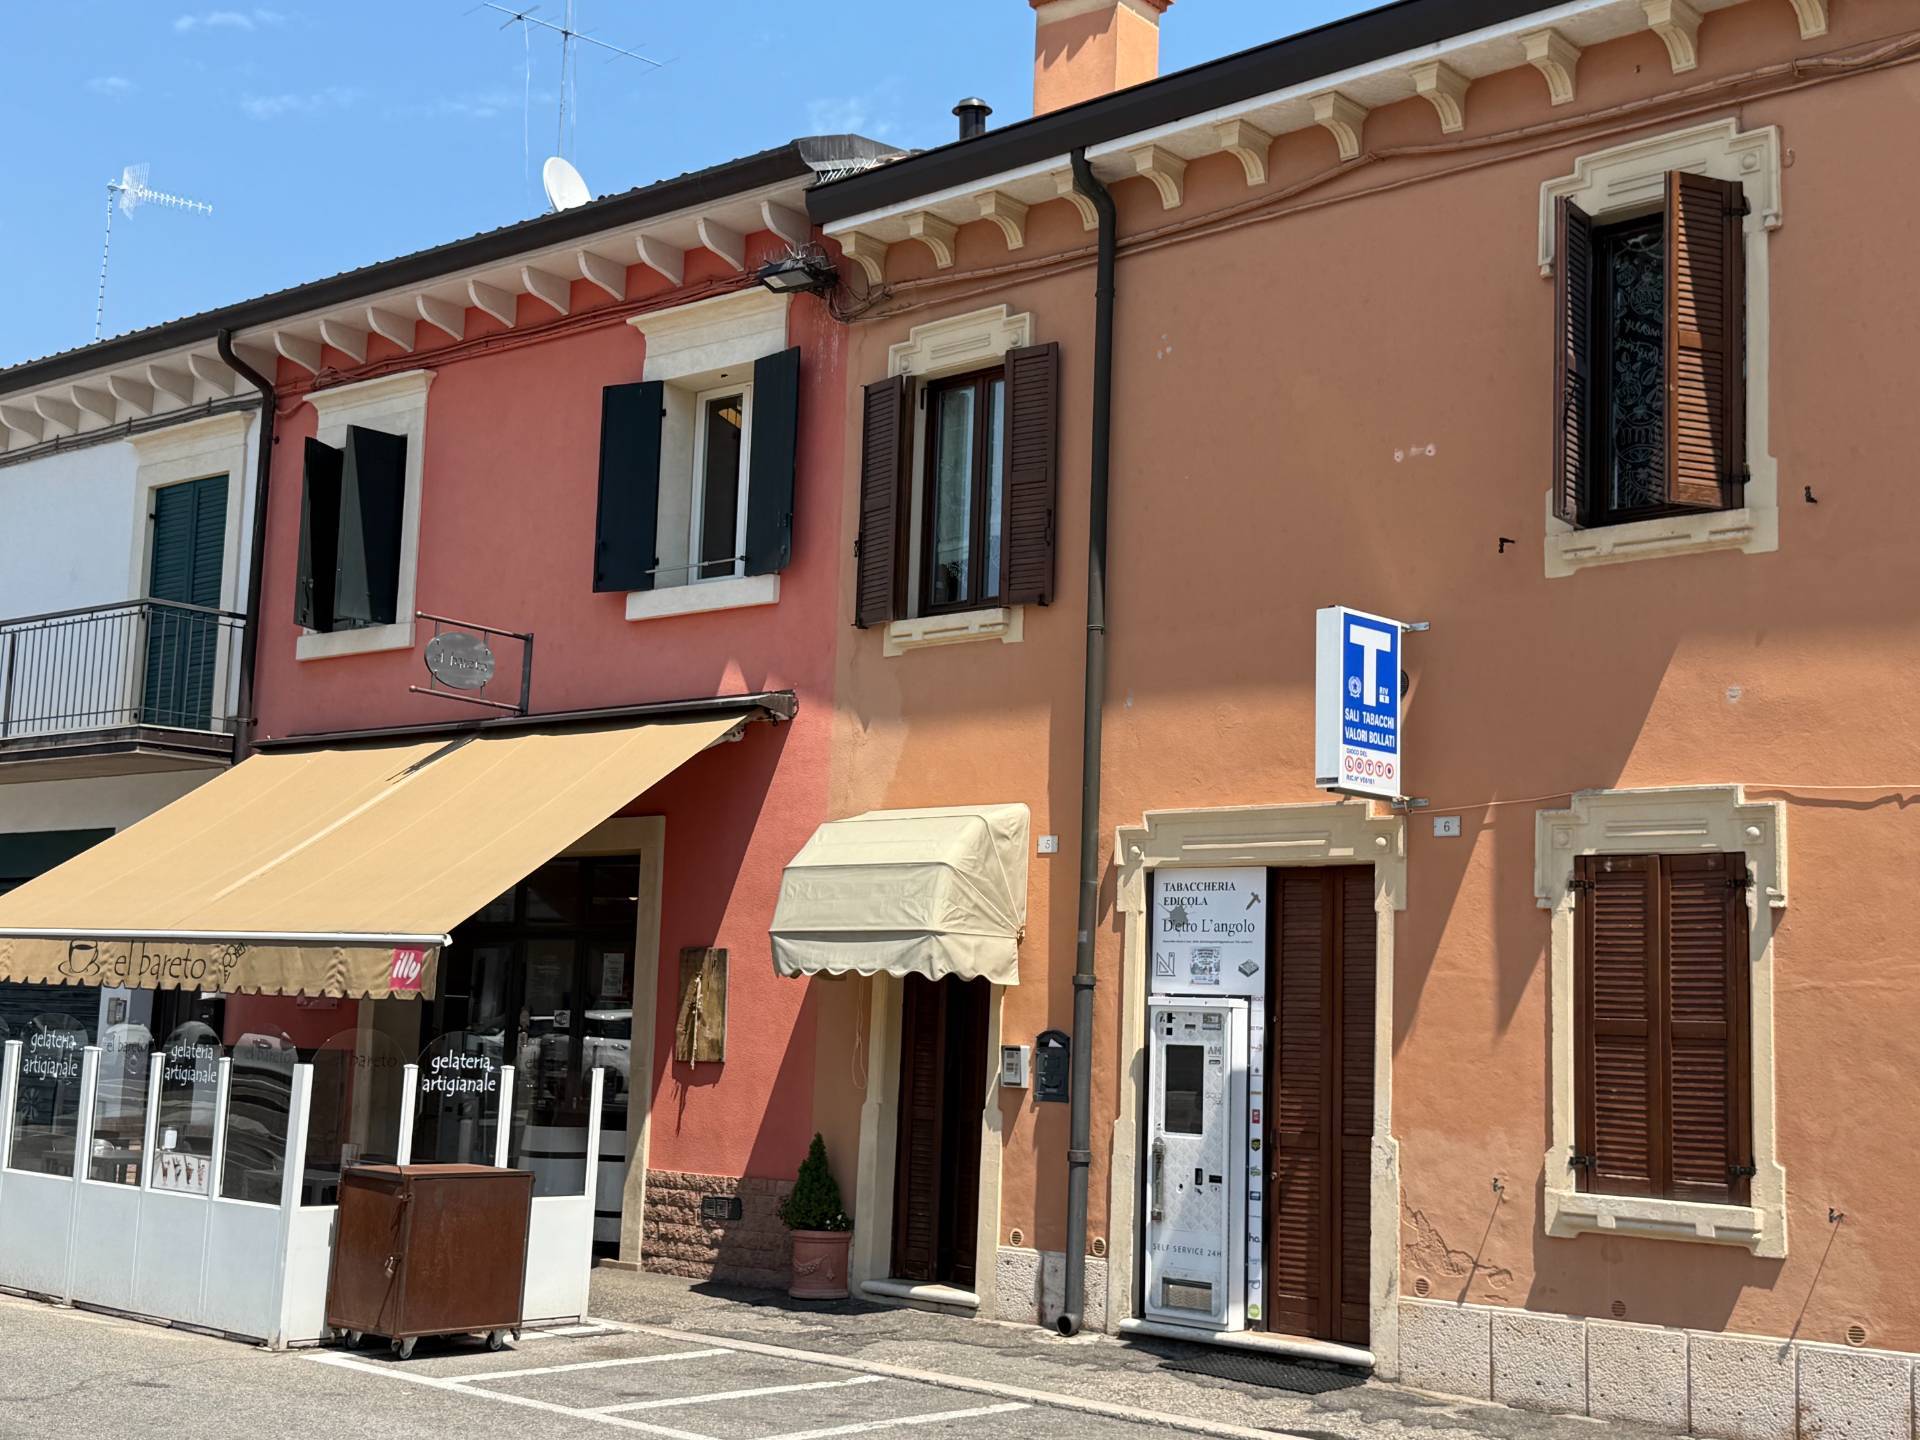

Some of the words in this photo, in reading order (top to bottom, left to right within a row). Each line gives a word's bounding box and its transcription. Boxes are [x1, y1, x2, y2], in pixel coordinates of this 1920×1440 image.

[1350, 623, 1391, 707] T
[1345, 707, 1359, 722] SALI
[1362, 711, 1394, 729] TABACCHI
[1345, 726, 1368, 742] VALORI
[1369, 731, 1395, 748] BOLLATI
[1443, 820, 1450, 832] 6
[1163, 882, 1236, 892] TABACCHERIA
[1163, 896, 1208, 906] EDICOLA
[1201, 918, 1255, 937] L'angolo
[114, 940, 134, 976] el
[139, 940, 206, 980] bareto
[392, 951, 421, 984] illy
[31, 1025, 75, 1053] gelateria
[171, 1038, 213, 1062] gelateria
[24, 1053, 78, 1080] artigianale
[431, 1049, 491, 1075] gelateria
[165, 1063, 216, 1086] artigianale
[422, 1072, 496, 1097] artigianale
[1152, 1243, 1170, 1252] SELF
[1173, 1245, 1204, 1256] SERVICE
[1207, 1249, 1222, 1257] 24H
